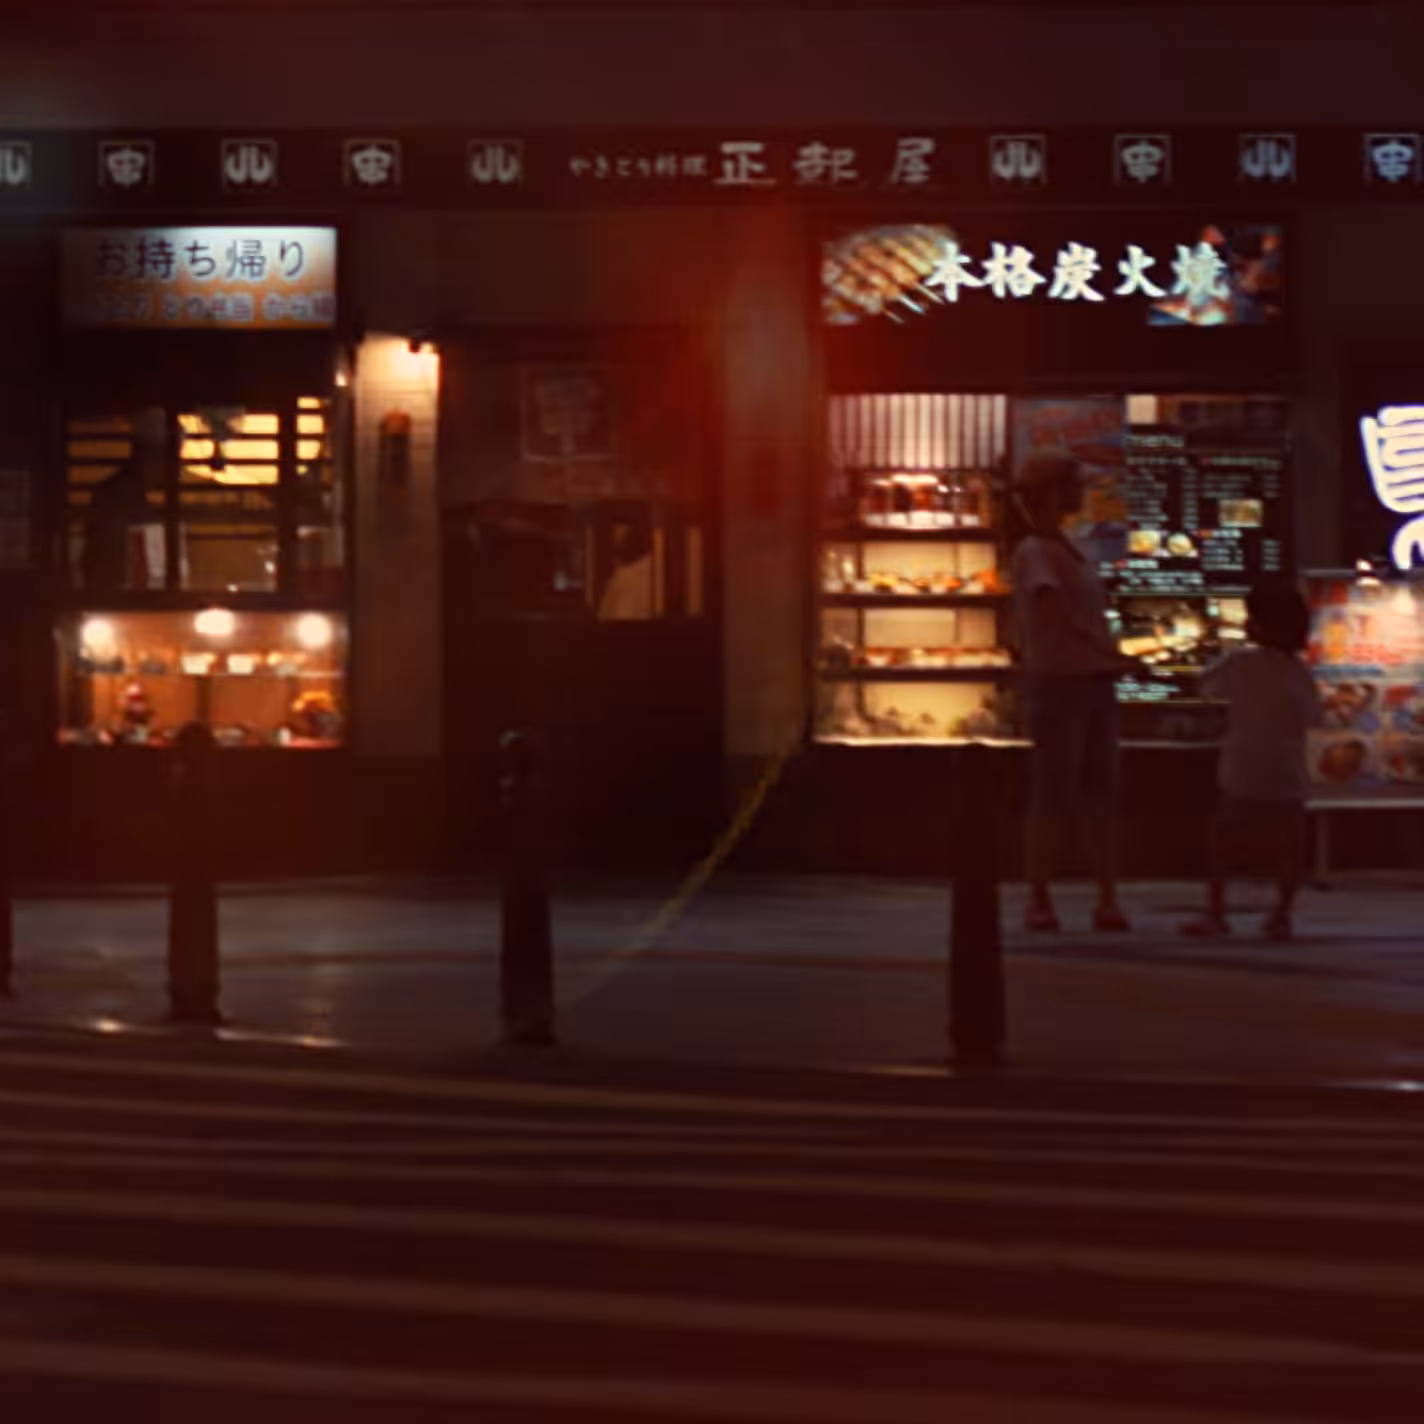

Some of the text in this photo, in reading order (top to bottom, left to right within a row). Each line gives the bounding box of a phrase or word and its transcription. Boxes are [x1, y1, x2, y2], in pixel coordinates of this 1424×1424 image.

[96, 238, 305, 279] お持ち帰り
[925, 240, 1232, 302] 本格炭火焼
